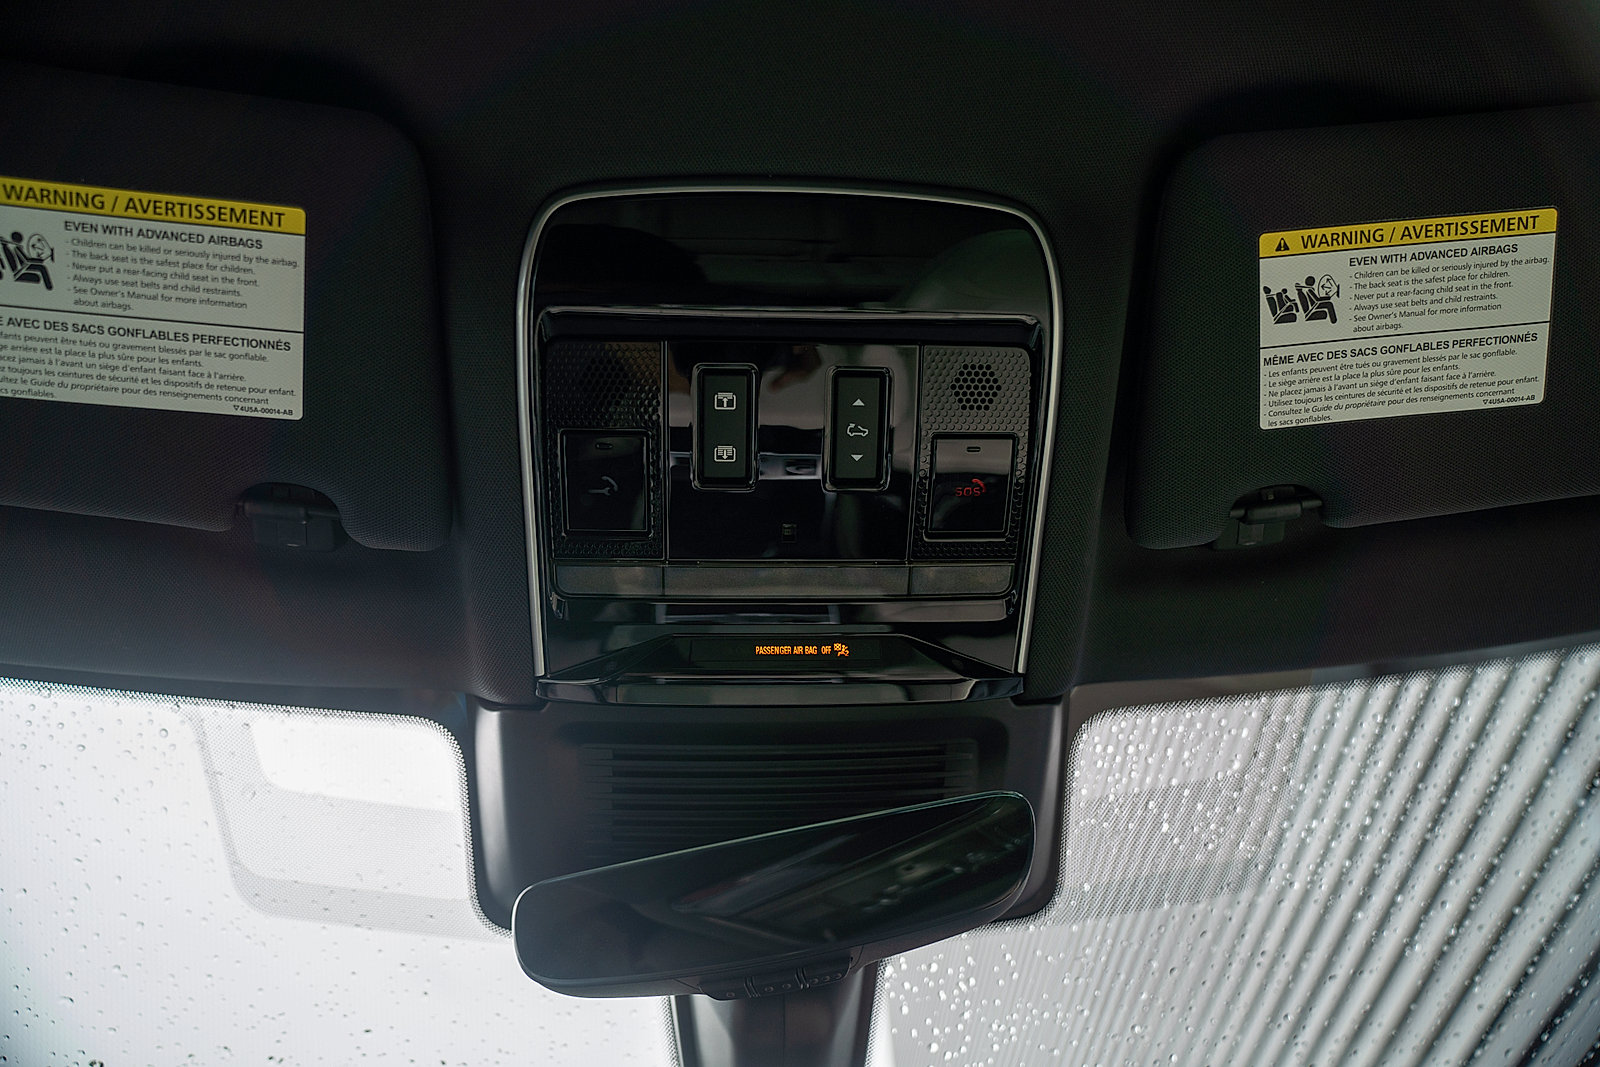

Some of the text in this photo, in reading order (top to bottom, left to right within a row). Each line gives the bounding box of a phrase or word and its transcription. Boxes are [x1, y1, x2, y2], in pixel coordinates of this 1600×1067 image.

[1, 183, 105, 210] WARNING
[124, 197, 285, 227] AVERTISSEMENT
[64, 220, 262, 249] EVEN WITH ADVANCED AIRBAGS
[1300, 228, 1384, 249] WARNING
[1399, 214, 1540, 240] AVERTISSEMENT
[1349, 243, 1518, 266] EVEN WITH ADVANCED AIRBAGS
[1353, 270, 1384, 279] Children
[1400, 267, 1410, 275] be
[1411, 265, 1430, 274] killed
[1441, 262, 1472, 272] seriously
[1473, 259, 1498, 270] injured
[1500, 259, 1509, 268] by
[1510, 257, 1523, 266] the
[72, 273, 102, 286] Always
[140, 280, 160, 289] belts
[162, 282, 178, 291] and
[180, 284, 200, 293] child
[1368, 280, 1386, 288] back
[1387, 279, 1402, 287] seat
[1424, 275, 1445, 284] safest
[1446, 274, 1466, 283] place
[1467, 272, 1478, 280] for
[72, 285, 88, 294] See
[89, 287, 125, 298] Owner's
[126, 290, 158, 300] Manual
[160, 293, 172, 302] for
[198, 297, 247, 308] information
[72, 297, 99, 307] about
[1353, 303, 1378, 311] Always
[1394, 300, 1409, 308] seat
[1410, 298, 1428, 306] belts
[1429, 296, 1443, 305] and
[1444, 294, 1462, 303] child
[1376, 291, 1388, 300] put
[1396, 287, 1434, 297] rear-facing
[1436, 284, 1453, 293] child
[1454, 284, 1469, 292] seat
[1353, 314, 1366, 322] See
[1367, 311, 1397, 320] Owner's
[1398, 308, 1426, 317] Manual
[1427, 307, 1438, 315] for
[1459, 302, 1501, 312] information
[6, 316, 40, 329] AVEC
[43, 320, 69, 332] DES
[71, 322, 104, 335] SACS
[107, 326, 189, 342] GONFLABLES
[192, 333, 291, 351] PERFECTIONNÉS
[1352, 324, 1374, 332] about
[1263, 331, 1538, 366] MÊME AVEC DES SACS GONFLABLES PERFECTIONNÉS
[1281, 367, 1308, 376] enfants
[1309, 364, 1338, 375] peuvent
[1355, 360, 1370, 369] tués
[1382, 357, 1420, 368] gravement
[1421, 353, 1446, 363] blessés
[1447, 354, 1460, 362] par
[1278, 378, 1296, 387] siège
[1297, 376, 1320, 384] arrière
[1341, 372, 1360, 381] place
[1369, 369, 1384, 379] plus
[1386, 368, 1401, 376] sûre
[1402, 367, 1420, 376] pour
[1279, 388, 1302, 398] placez
[1302, 385, 1326, 396] jamais
[1333, 382, 1357, 390] l'avant
[1369, 380, 1388, 388] siège
[1389, 376, 1419, 385] d'enfant
[1420, 374, 1444, 382] faisant
[1268, 399, 1292, 407] Utilisez
[1294, 396, 1322, 405] toujours
[1334, 392, 1365, 400] ceintures
[1376, 387, 1403, 396] sécurité
[1423, 382, 1458, 393] dispositifs
[1458, 381, 1468, 389] de
[1469, 380, 1496, 388] retenue
[1496, 378, 1514, 387] pour
[1268, 407, 1302, 417] Consultez
[1311, 404, 1332, 412] Guide
[1344, 399, 1386, 411] propriétaire
[1387, 398, 1404, 407] pour
[1419, 391, 1474, 402] renseignements
[1475, 387, 1514, 397] concernant
[955, 486, 980, 496] SOS
[755, 646, 831, 654] PASSENGER AIR BAG OFF
